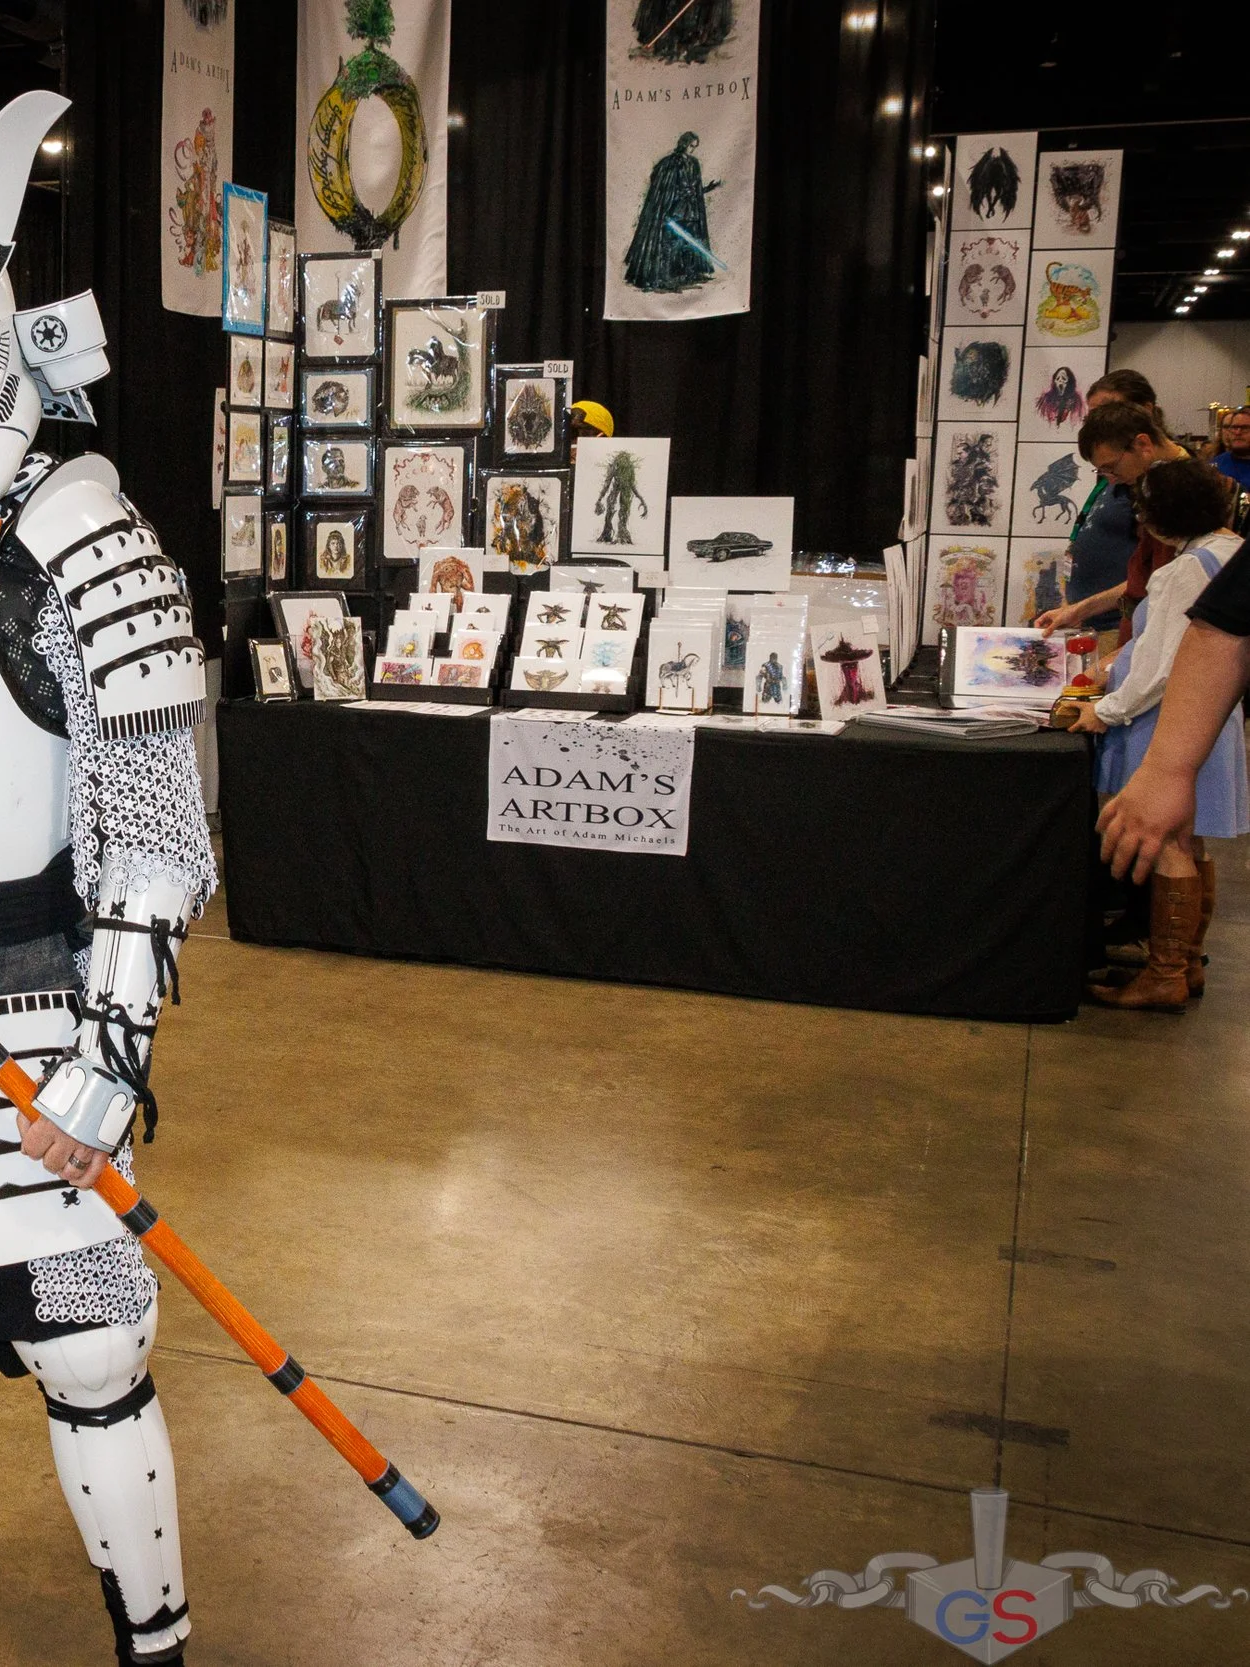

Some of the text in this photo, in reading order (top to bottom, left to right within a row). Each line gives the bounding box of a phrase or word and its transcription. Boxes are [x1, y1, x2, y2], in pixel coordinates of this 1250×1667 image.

[612, 77, 750, 110] ADAM'S ARTBOX
[480, 294, 500, 306] SOLD
[547, 362, 569, 374] SOLD
[502, 765, 676, 796] ADAM'S
[498, 798, 677, 830] ARTBOX
[499, 824, 676, 845] The Art of Adam Michaels
